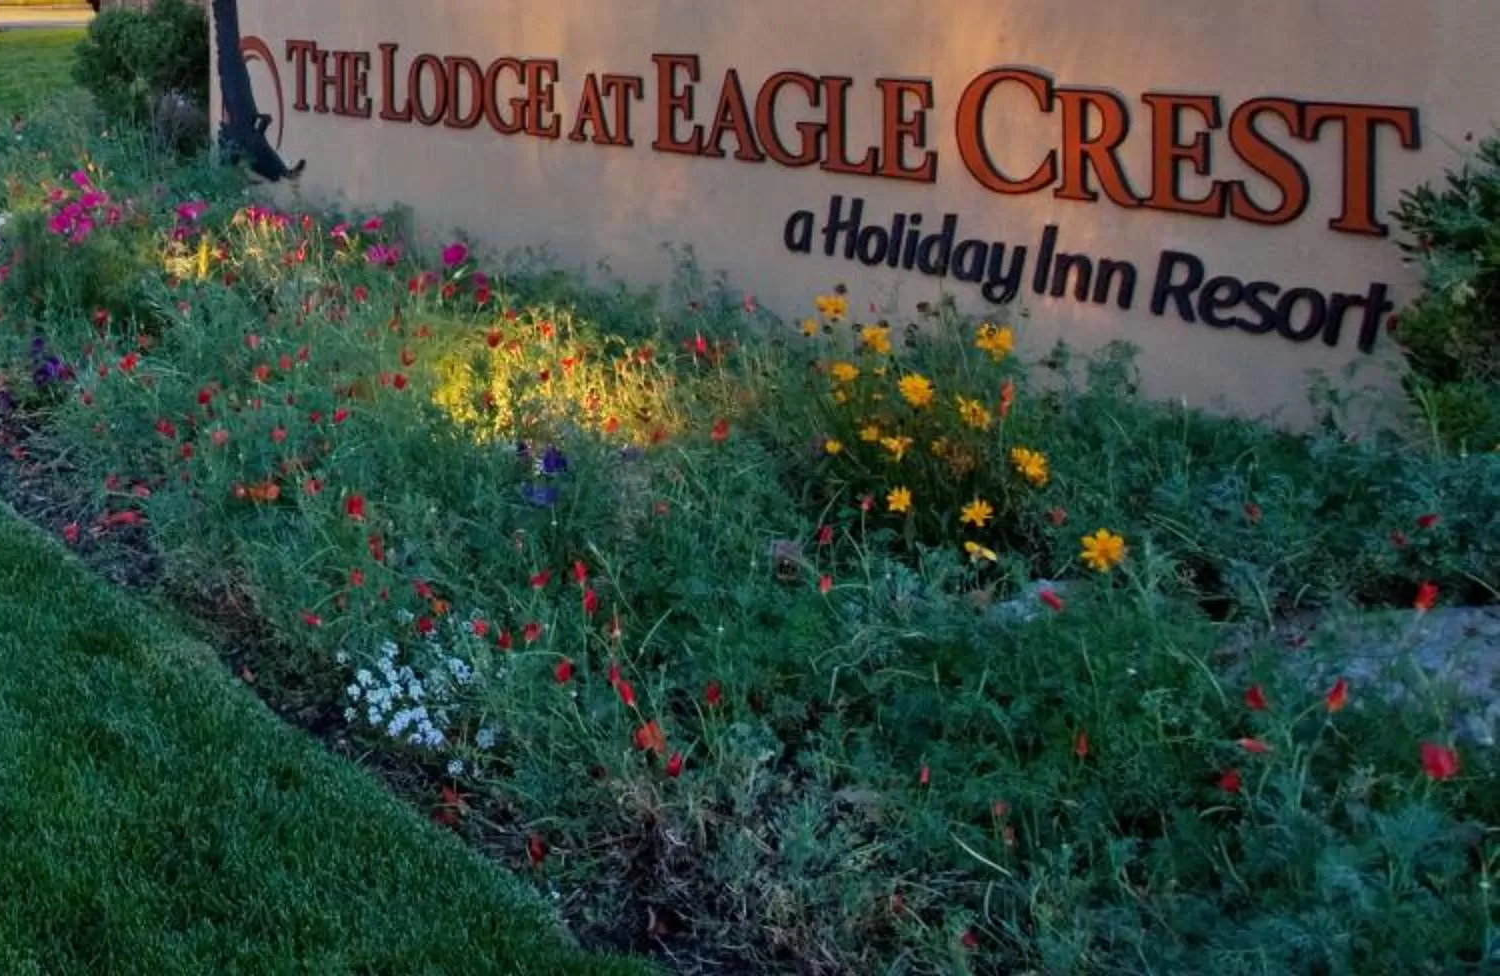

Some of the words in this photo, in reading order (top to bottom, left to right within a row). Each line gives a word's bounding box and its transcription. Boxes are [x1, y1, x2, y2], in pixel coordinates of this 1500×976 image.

[285, 38, 372, 119] THE
[378, 41, 561, 141] LODGE
[568, 72, 645, 148] AT
[650, 52, 939, 185] EAGLE
[954, 67, 1422, 238] CREST
[783, 208, 814, 256] a
[821, 194, 1029, 305] Holiday
[1034, 224, 1138, 311] Inn
[1150, 249, 1396, 356] Resort
